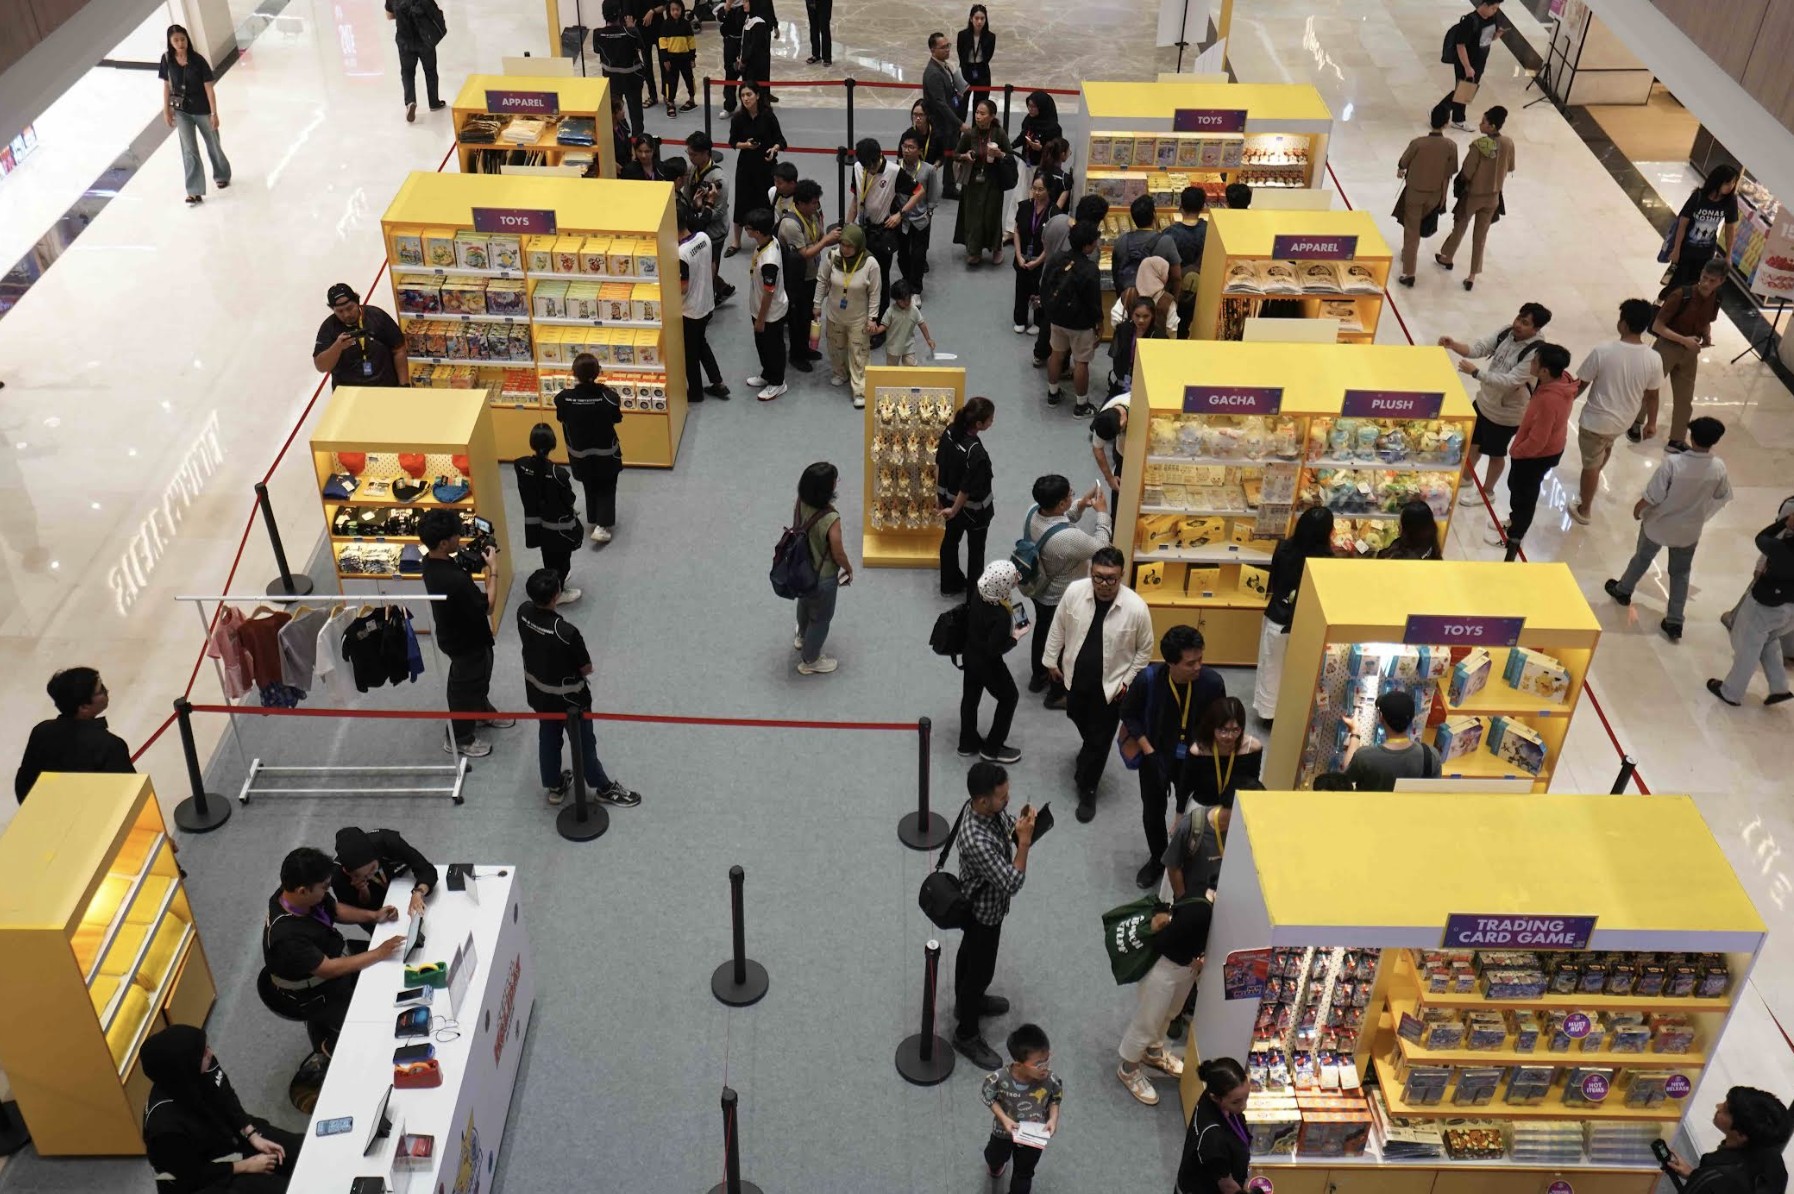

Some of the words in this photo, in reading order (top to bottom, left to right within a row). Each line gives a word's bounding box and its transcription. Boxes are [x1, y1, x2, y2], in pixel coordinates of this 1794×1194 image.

[502, 98, 544, 107] APPAREL
[1197, 116, 1223, 125] TOYS
[1698, 209, 1725, 217] JONAS
[500, 216, 530, 226] TOYS
[1290, 243, 1339, 252] APPAREL
[1208, 395, 1256, 406] GACHA
[1371, 399, 1414, 410] PLUSH
[1443, 625, 1484, 636] TOYS
[1477, 919, 1565, 932] TRADING
[1458, 931, 1512, 943] CARD
[1517, 932, 1576, 944] GAME
